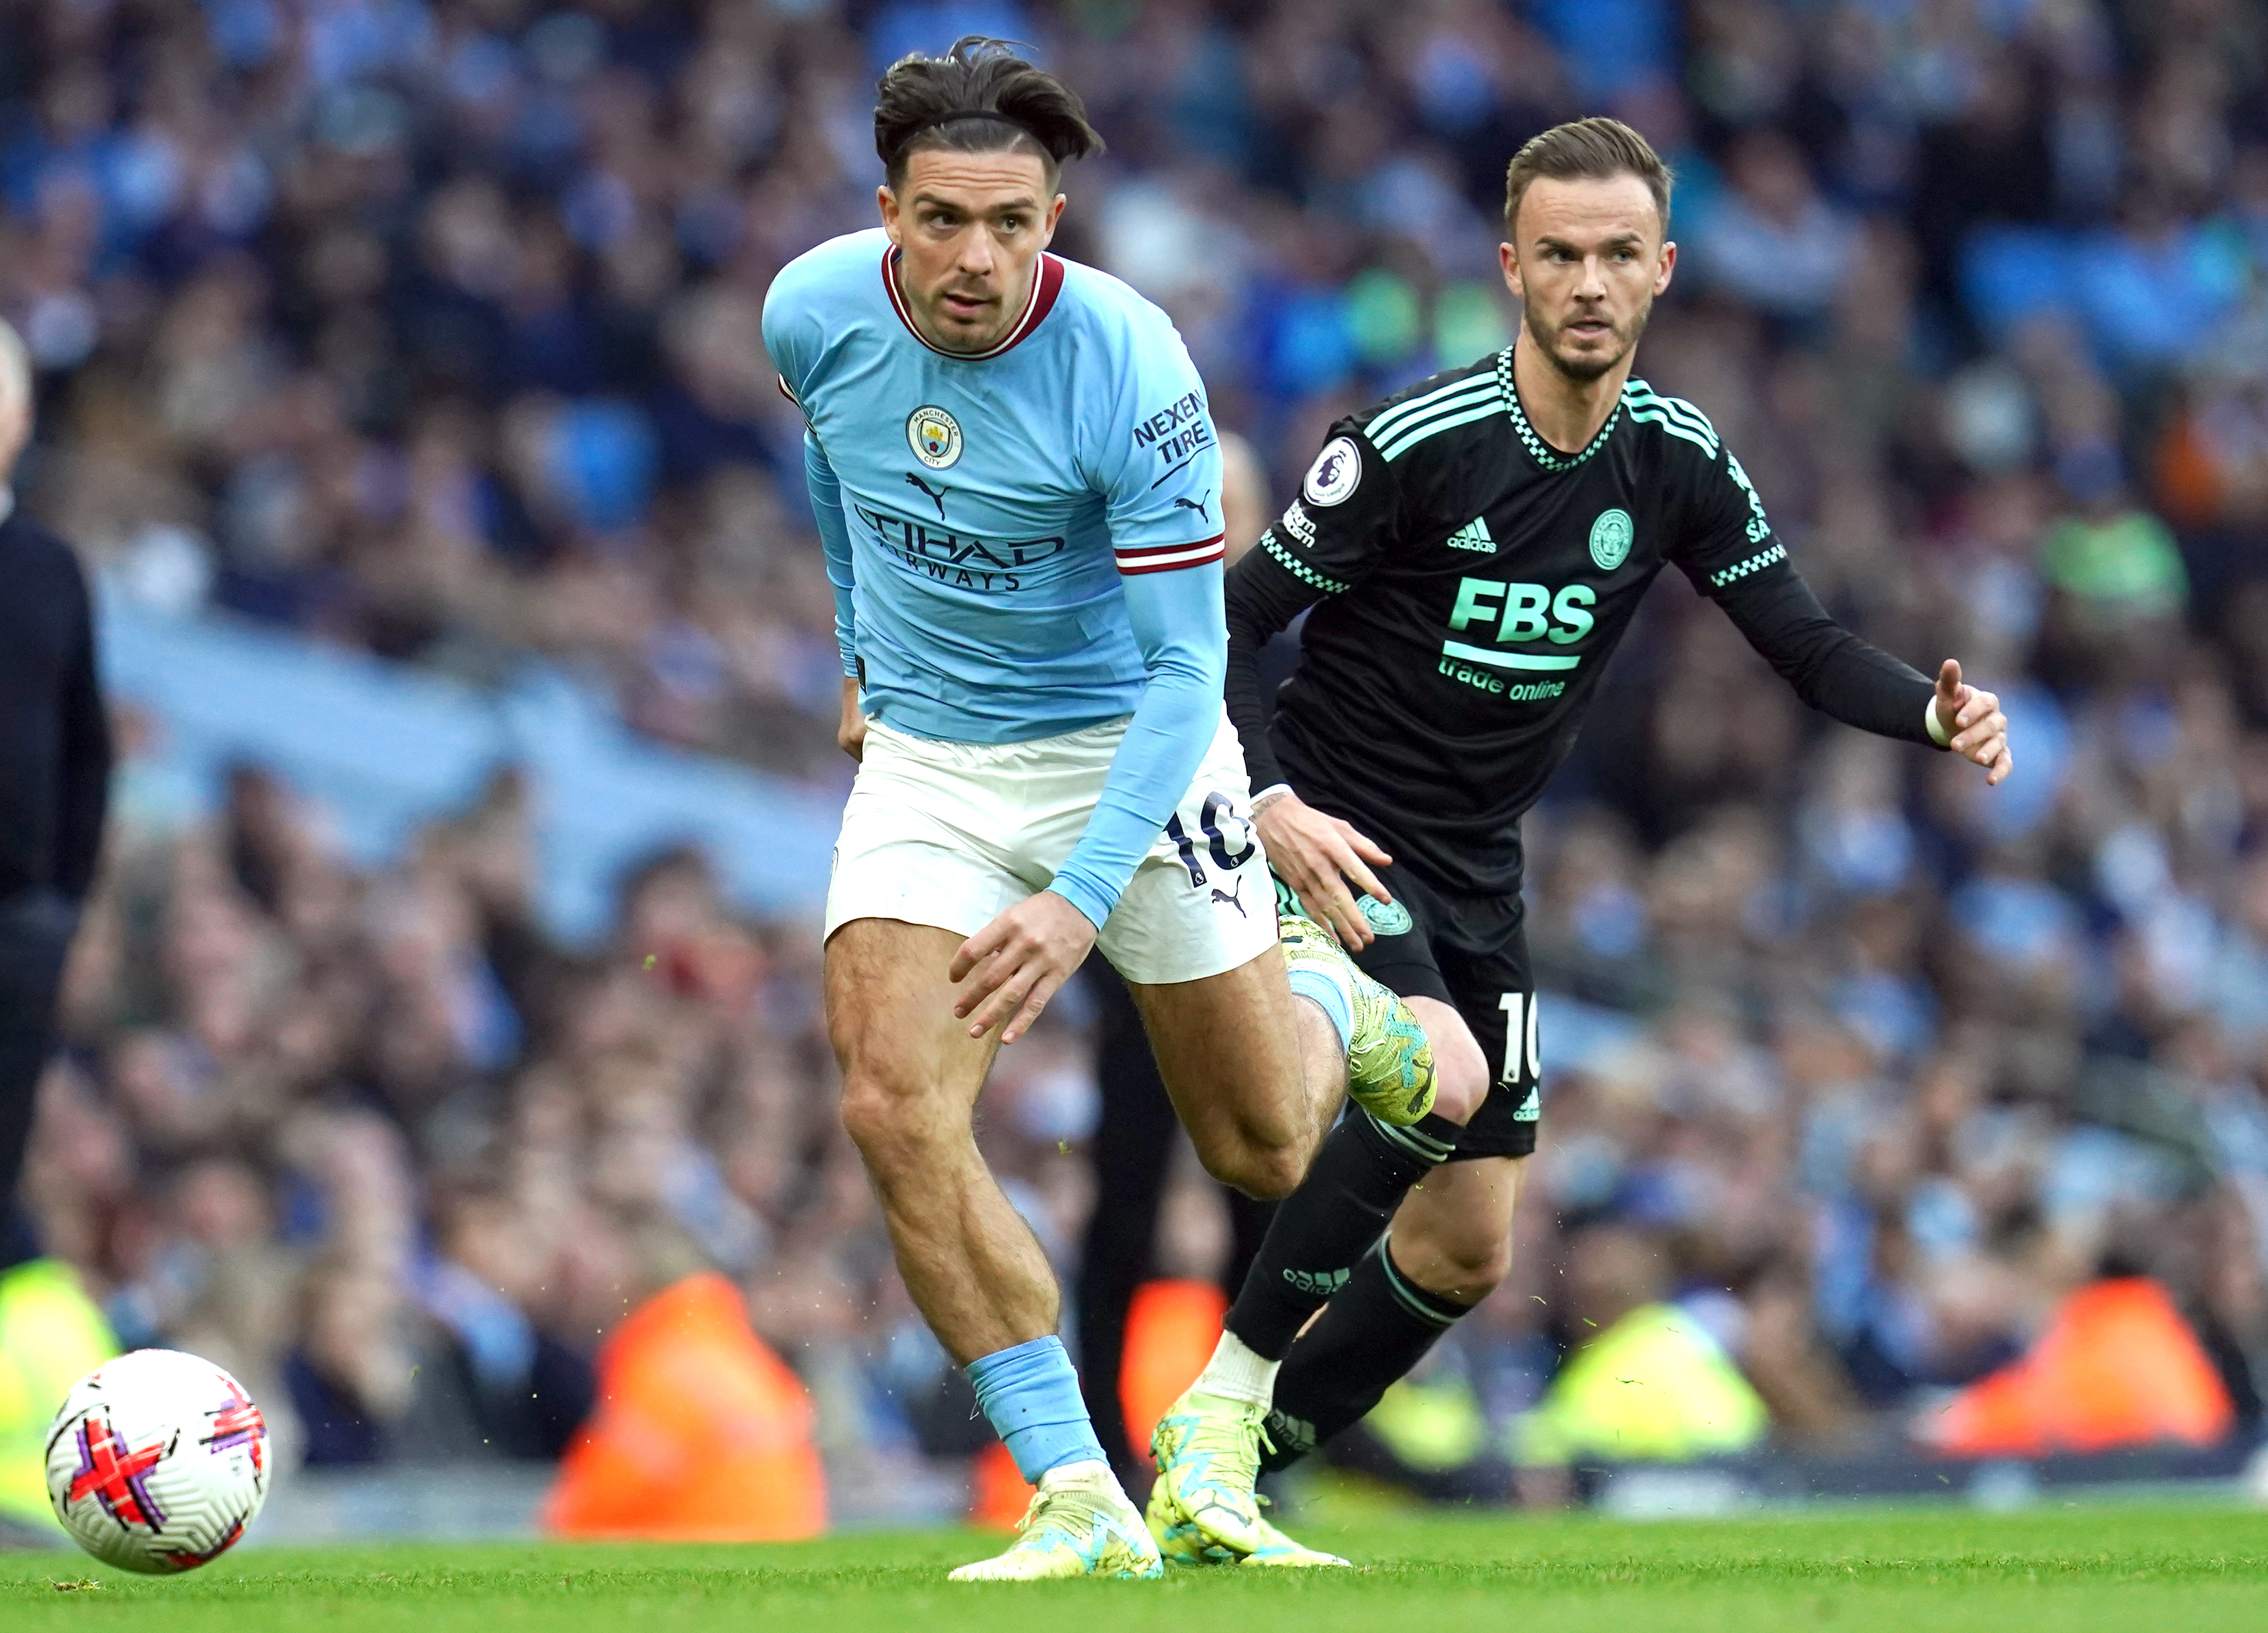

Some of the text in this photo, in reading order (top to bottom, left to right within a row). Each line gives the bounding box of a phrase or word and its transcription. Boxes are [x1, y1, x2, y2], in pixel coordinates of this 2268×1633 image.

[914, 410, 959, 437] MANCHESTER
[1134, 389, 1205, 448] NEXEN
[924, 456, 940, 466] CITY
[1157, 420, 1209, 464] TIRE
[1447, 537, 1497, 554] adidas
[1447, 577, 1596, 644] FBS
[1438, 656, 1565, 700] trade online
[1162, 791, 1255, 888] 10
